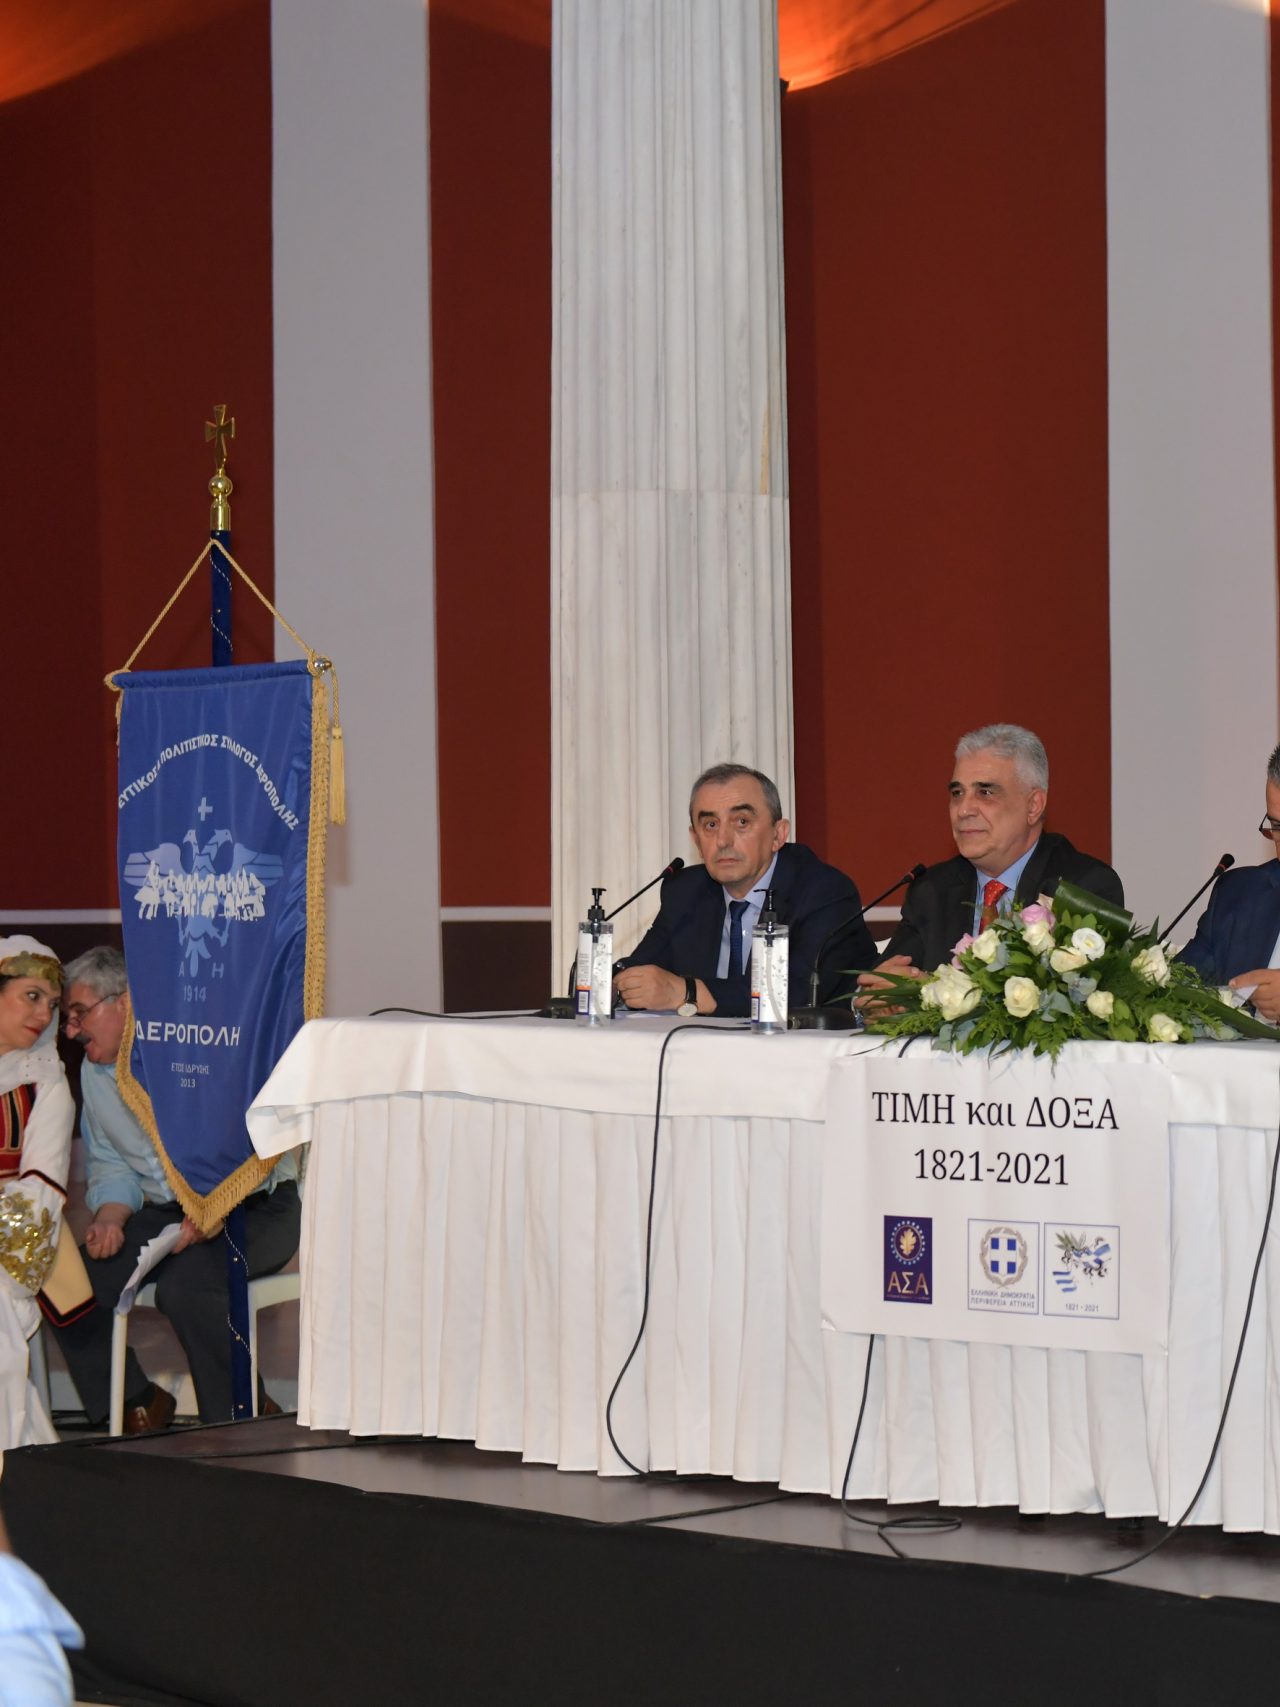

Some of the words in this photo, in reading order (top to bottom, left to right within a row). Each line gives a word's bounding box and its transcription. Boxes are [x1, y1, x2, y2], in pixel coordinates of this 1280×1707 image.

[180, 1077, 196, 1089] 2013
[871, 1091, 956, 1125] ΤΙΜΗ
[965, 1100, 1016, 1127] και
[1026, 1096, 1120, 1130] ΔΟΞΑ
[914, 1148, 1069, 1186] 1821-2021
